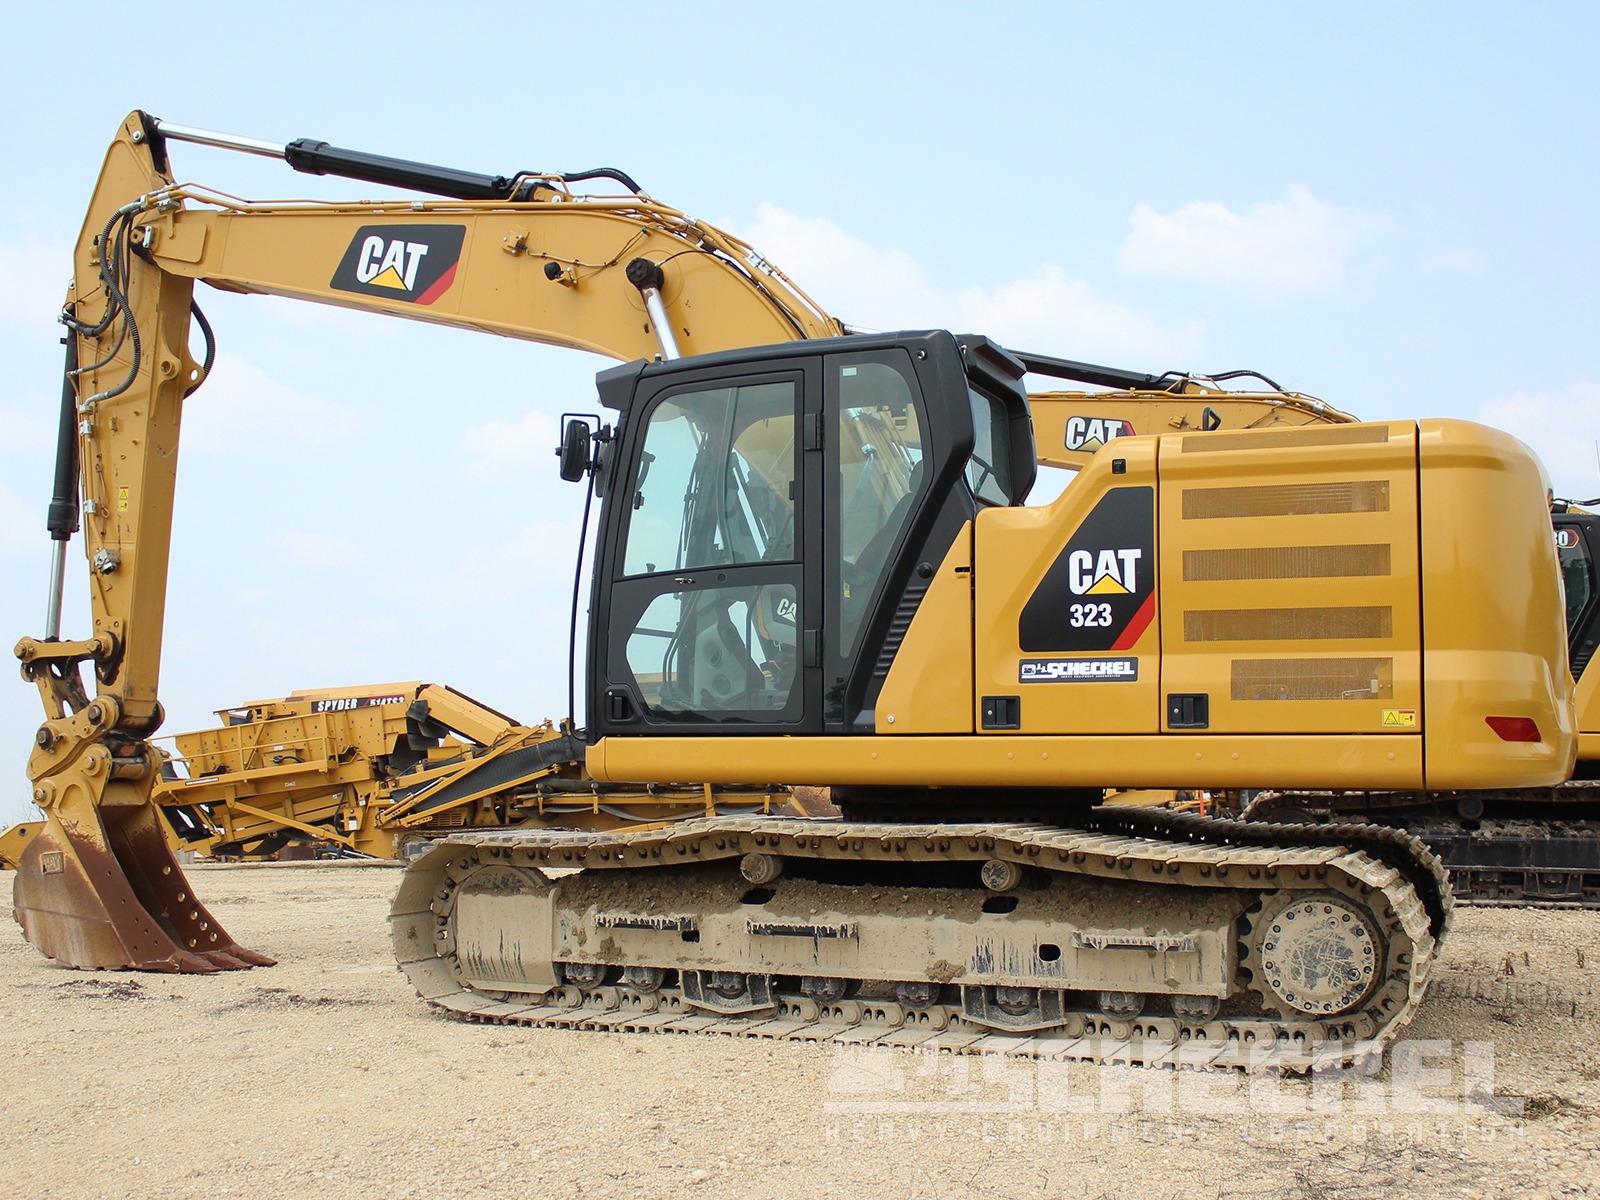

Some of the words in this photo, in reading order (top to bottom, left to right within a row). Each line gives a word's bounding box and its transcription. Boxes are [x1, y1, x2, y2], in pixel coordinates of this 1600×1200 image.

[356, 235, 429, 292] CAT
[1065, 417, 1123, 451] CAT
[1069, 548, 1142, 596] CAT
[1069, 603, 1113, 628] 323
[1045, 661, 1135, 678] SCHECKEL
[317, 698, 358, 712] SPYDER
